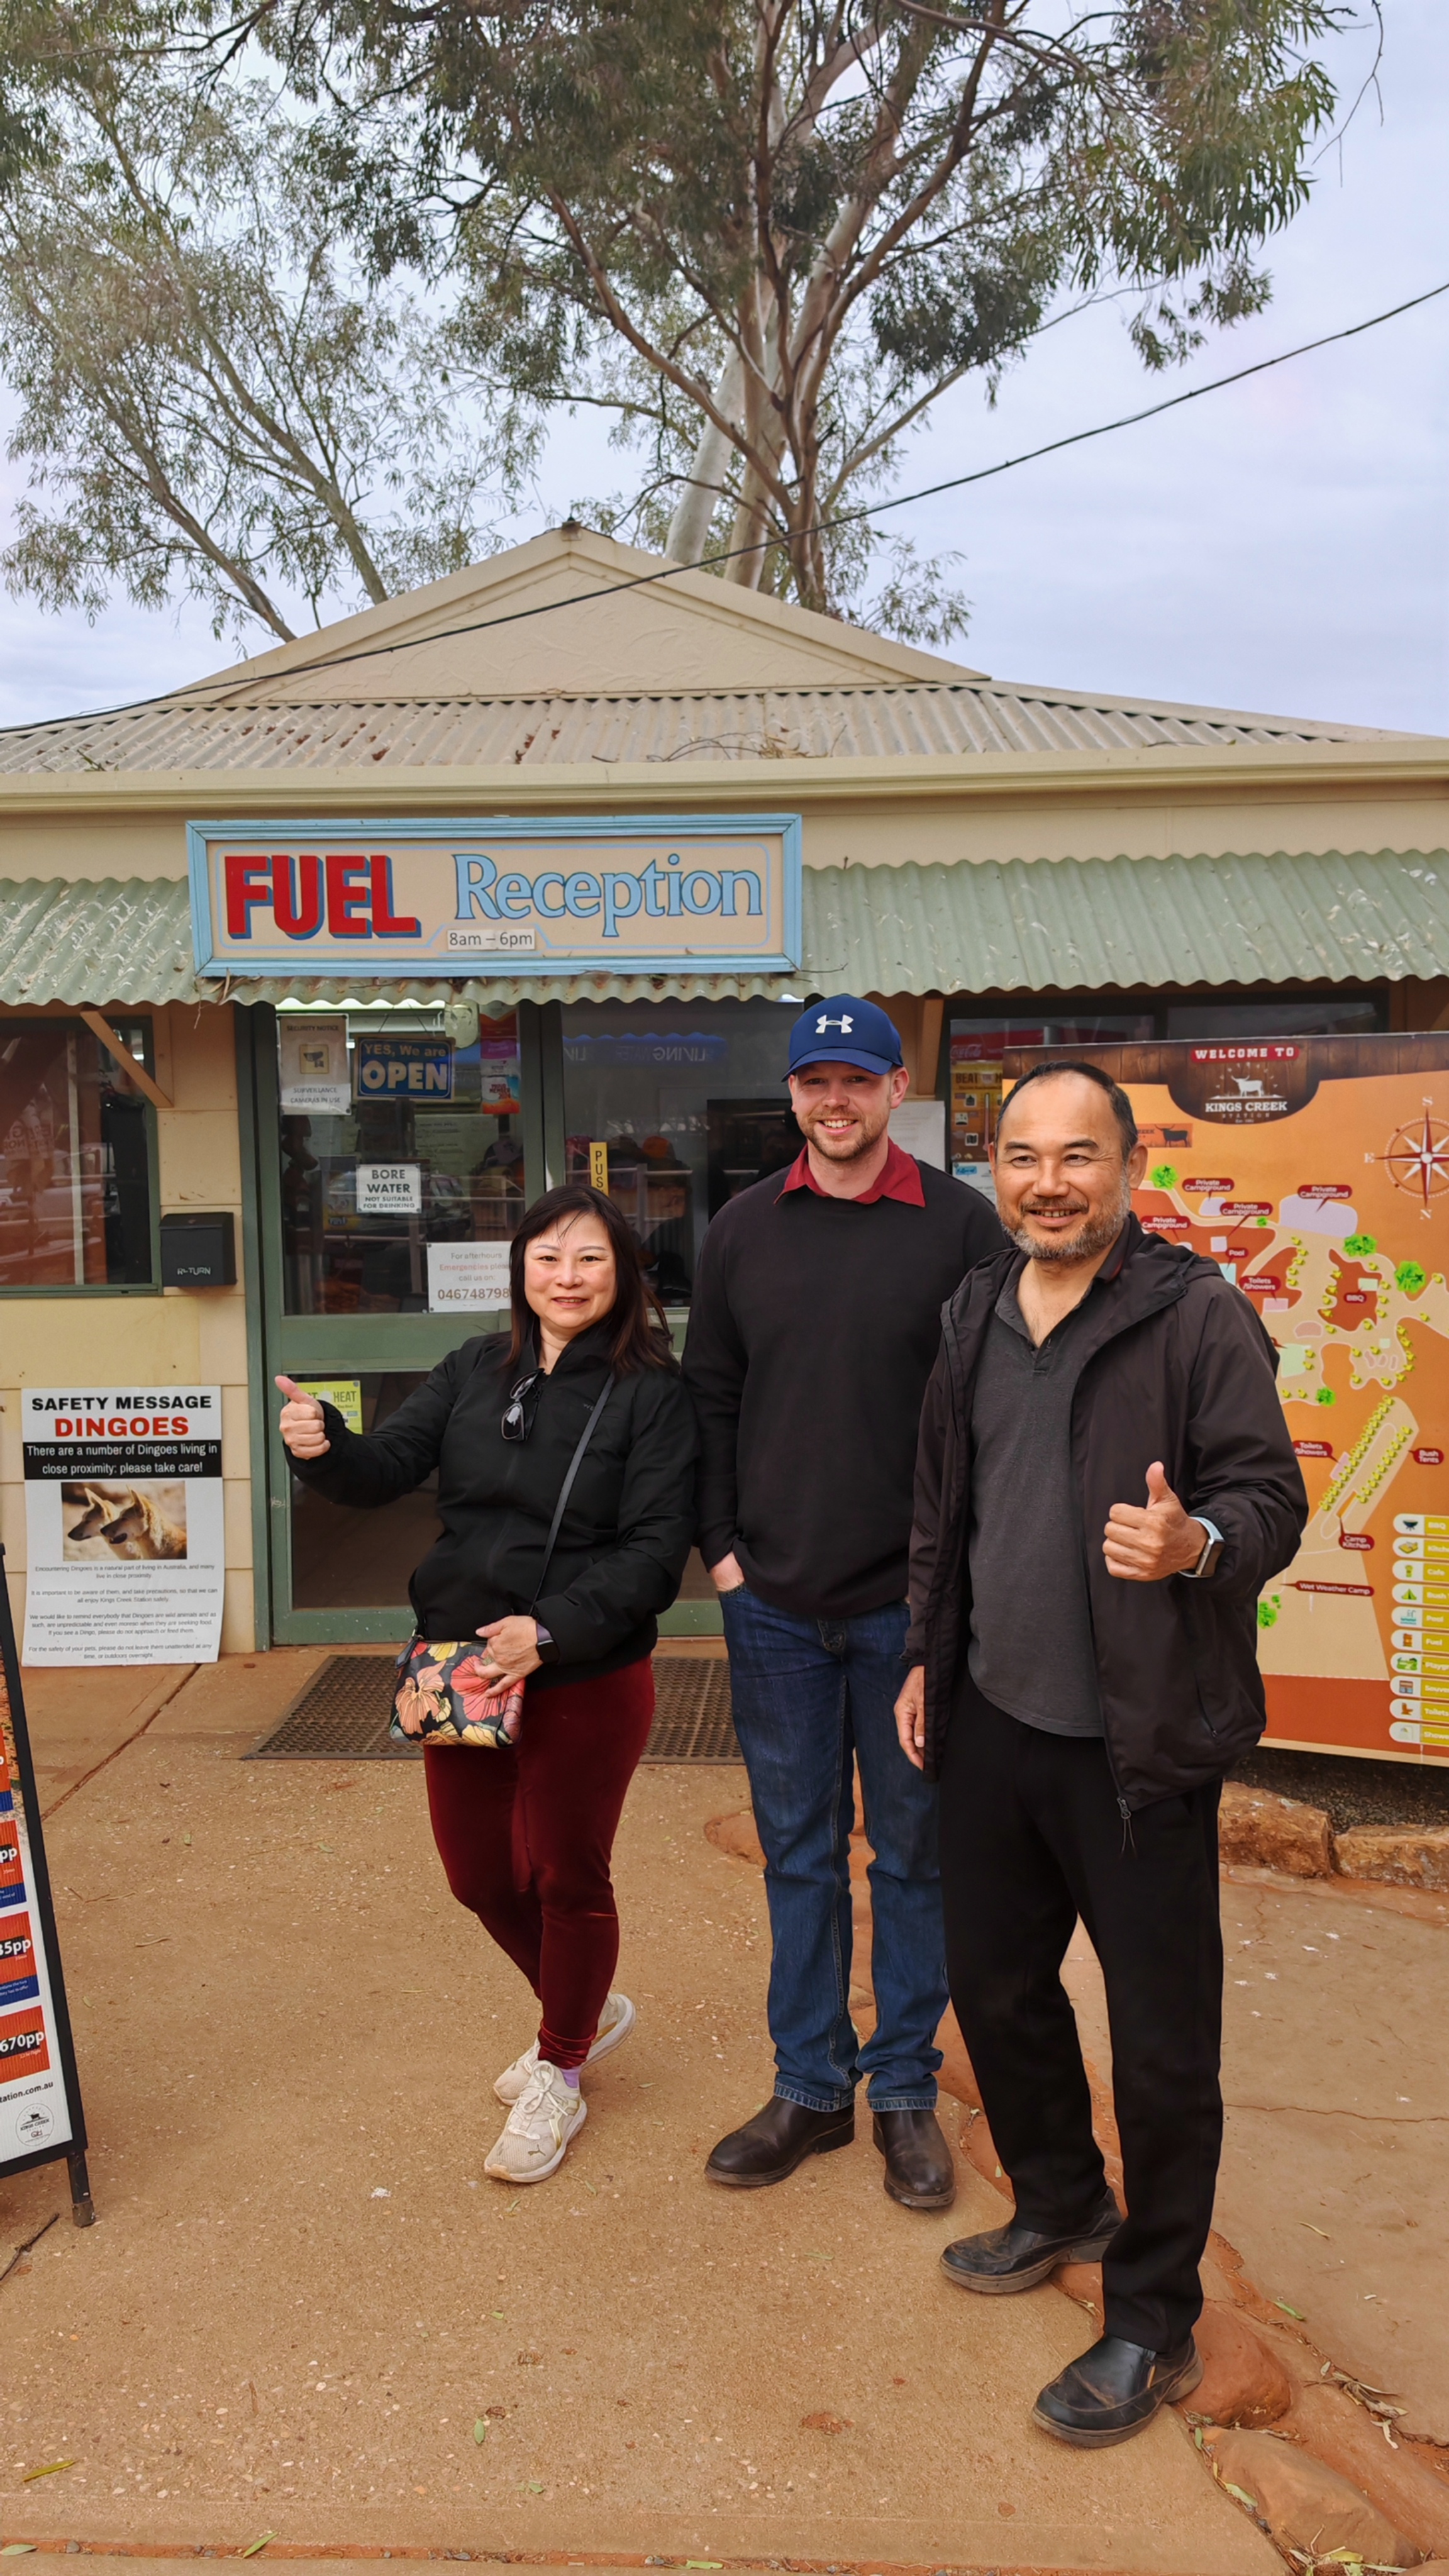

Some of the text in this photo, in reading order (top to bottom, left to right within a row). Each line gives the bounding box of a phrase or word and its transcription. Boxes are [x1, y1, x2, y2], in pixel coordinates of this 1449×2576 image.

[225, 853, 763, 940] FUEL Reception
[449, 932, 482, 946] 8am
[499, 931, 533, 948] 6pm
[364, 1044, 447, 1057] YES, We are
[1195, 1047, 1294, 1059] WELCOME TO
[362, 1060, 447, 1091] OPEN
[1205, 1101, 1288, 1113] KINGS CREEK
[1422, 1096, 1433, 1106] S
[1364, 1152, 1375, 1163] E
[372, 1170, 406, 1179] BORE
[595, 1150, 604, 1192] PUS
[367, 1184, 411, 1193] WATER
[1419, 1209, 1433, 1220] N
[438, 1288, 510, 1300] 046748798
[1346, 1294, 1365, 1302] BBQ
[333, 1391, 357, 1402] HEAT
[32, 1396, 211, 1411] SAFETY MESSAGE
[55, 1416, 189, 1437] DINGOES
[26, 1442, 218, 1457] There are a number of Dingoes living in
[1299, 1441, 1323, 1450] Toilets
[42, 1461, 203, 1475] close proximity: please take care!
[1316, 1584, 1346, 1592] Weather
[1348, 1587, 1370, 1595] Camp
[0, 2031, 45, 2053] 670pp
